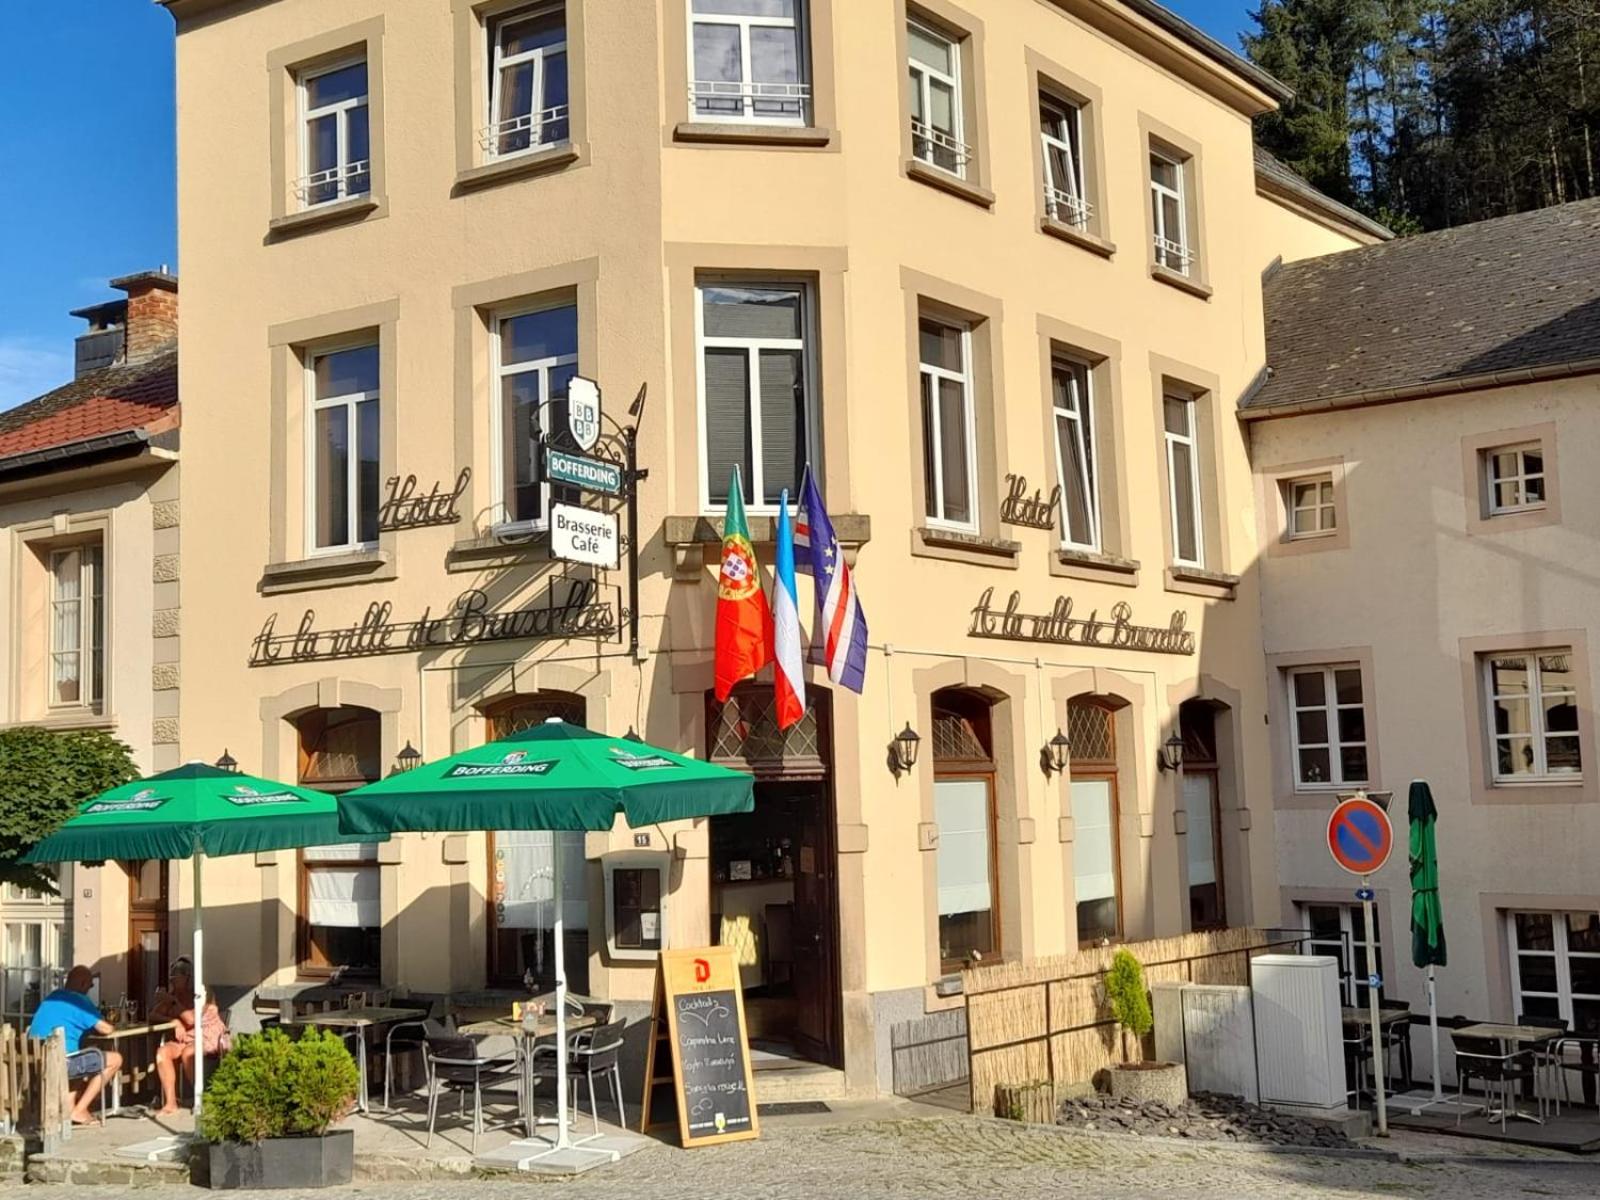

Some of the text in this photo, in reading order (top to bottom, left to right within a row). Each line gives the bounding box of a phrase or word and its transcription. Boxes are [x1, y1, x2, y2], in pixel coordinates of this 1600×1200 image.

[551, 457, 616, 486] BOFFERDING
[557, 514, 612, 539] Brasserie
[571, 535, 600, 554] Café
[290, 608, 318, 660] la
[330, 599, 395, 655] ville
[407, 606, 442, 650] de
[450, 578, 615, 643] Bruxelles
[1002, 589, 1024, 638] la
[1030, 595, 1074, 642] ville
[1081, 609, 1101, 645] de
[1109, 601, 1196, 654] Bruxelles
[452, 763, 549, 777] BOFFERDING
